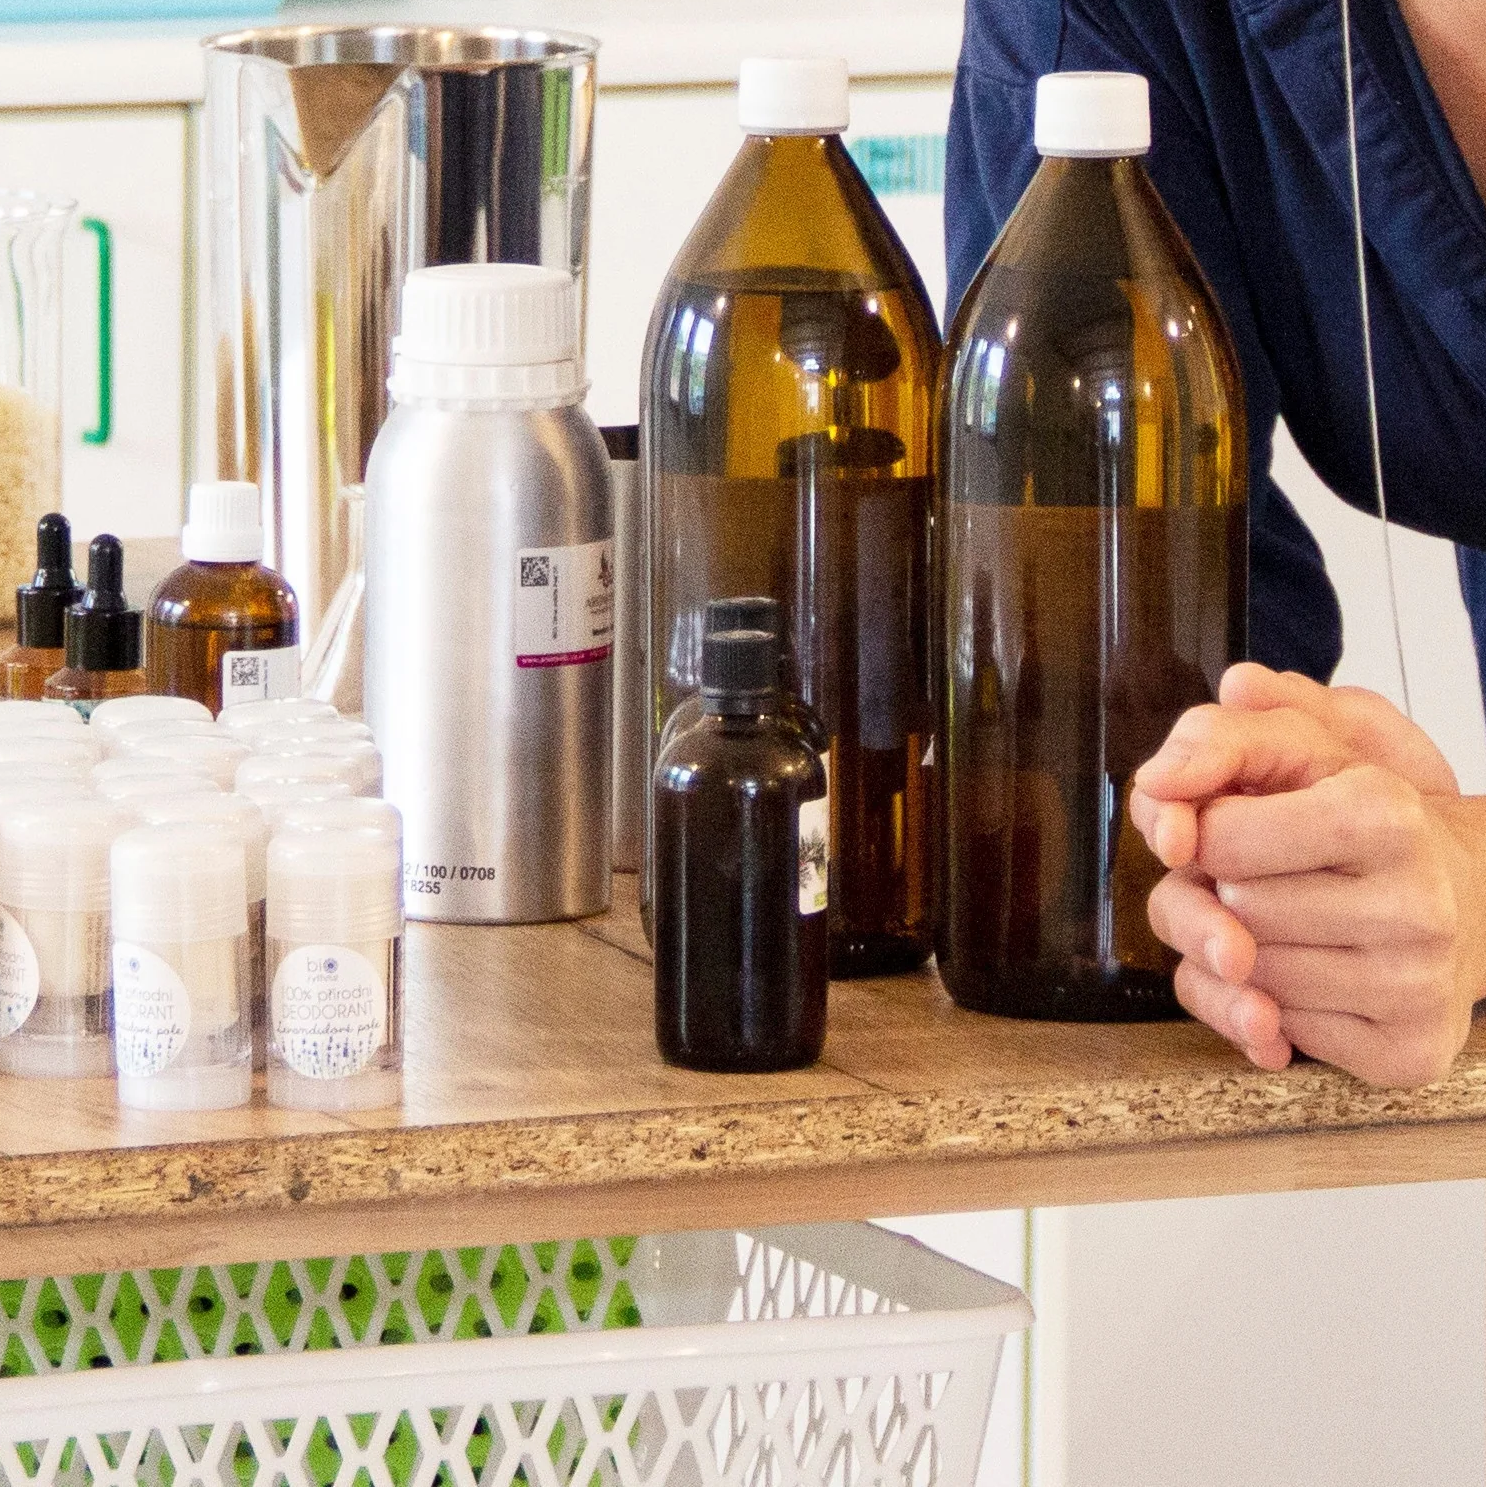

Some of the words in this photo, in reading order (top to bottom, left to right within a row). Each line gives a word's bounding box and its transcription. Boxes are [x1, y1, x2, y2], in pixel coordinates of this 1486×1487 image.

[424, 864, 448, 879] 100
[460, 866, 496, 882] 0708
[281, 999, 374, 1021] DEODORANT
